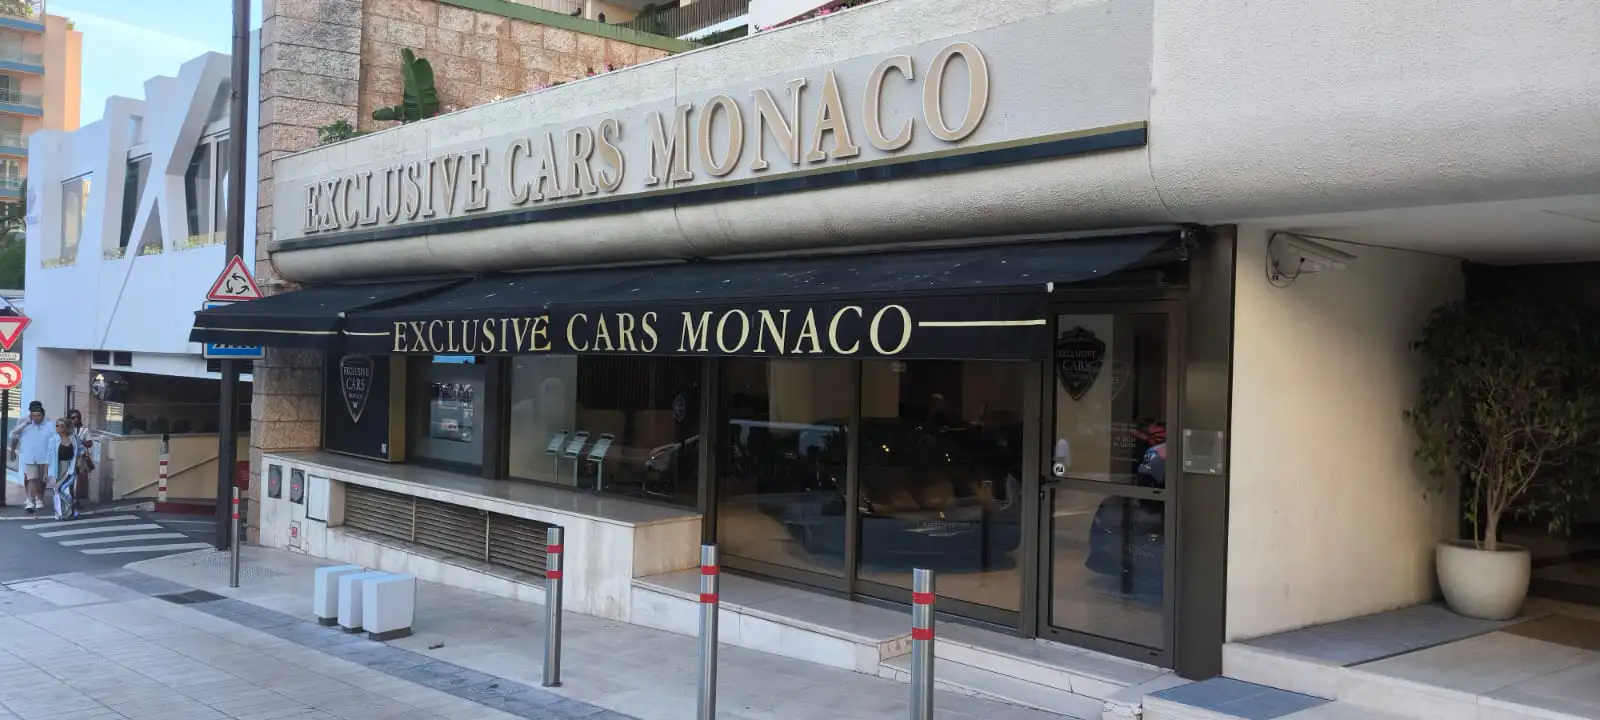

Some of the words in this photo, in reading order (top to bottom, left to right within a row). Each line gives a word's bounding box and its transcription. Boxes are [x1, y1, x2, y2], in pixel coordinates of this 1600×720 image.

[303, 146, 489, 234] EXCLUSIVE
[508, 117, 625, 206] CARS
[644, 40, 990, 187] MONACO
[392, 315, 552, 354] EXCLUSIVE
[566, 311, 659, 352] CARS
[680, 304, 912, 356] MONACO
[346, 378, 365, 391] CARS
